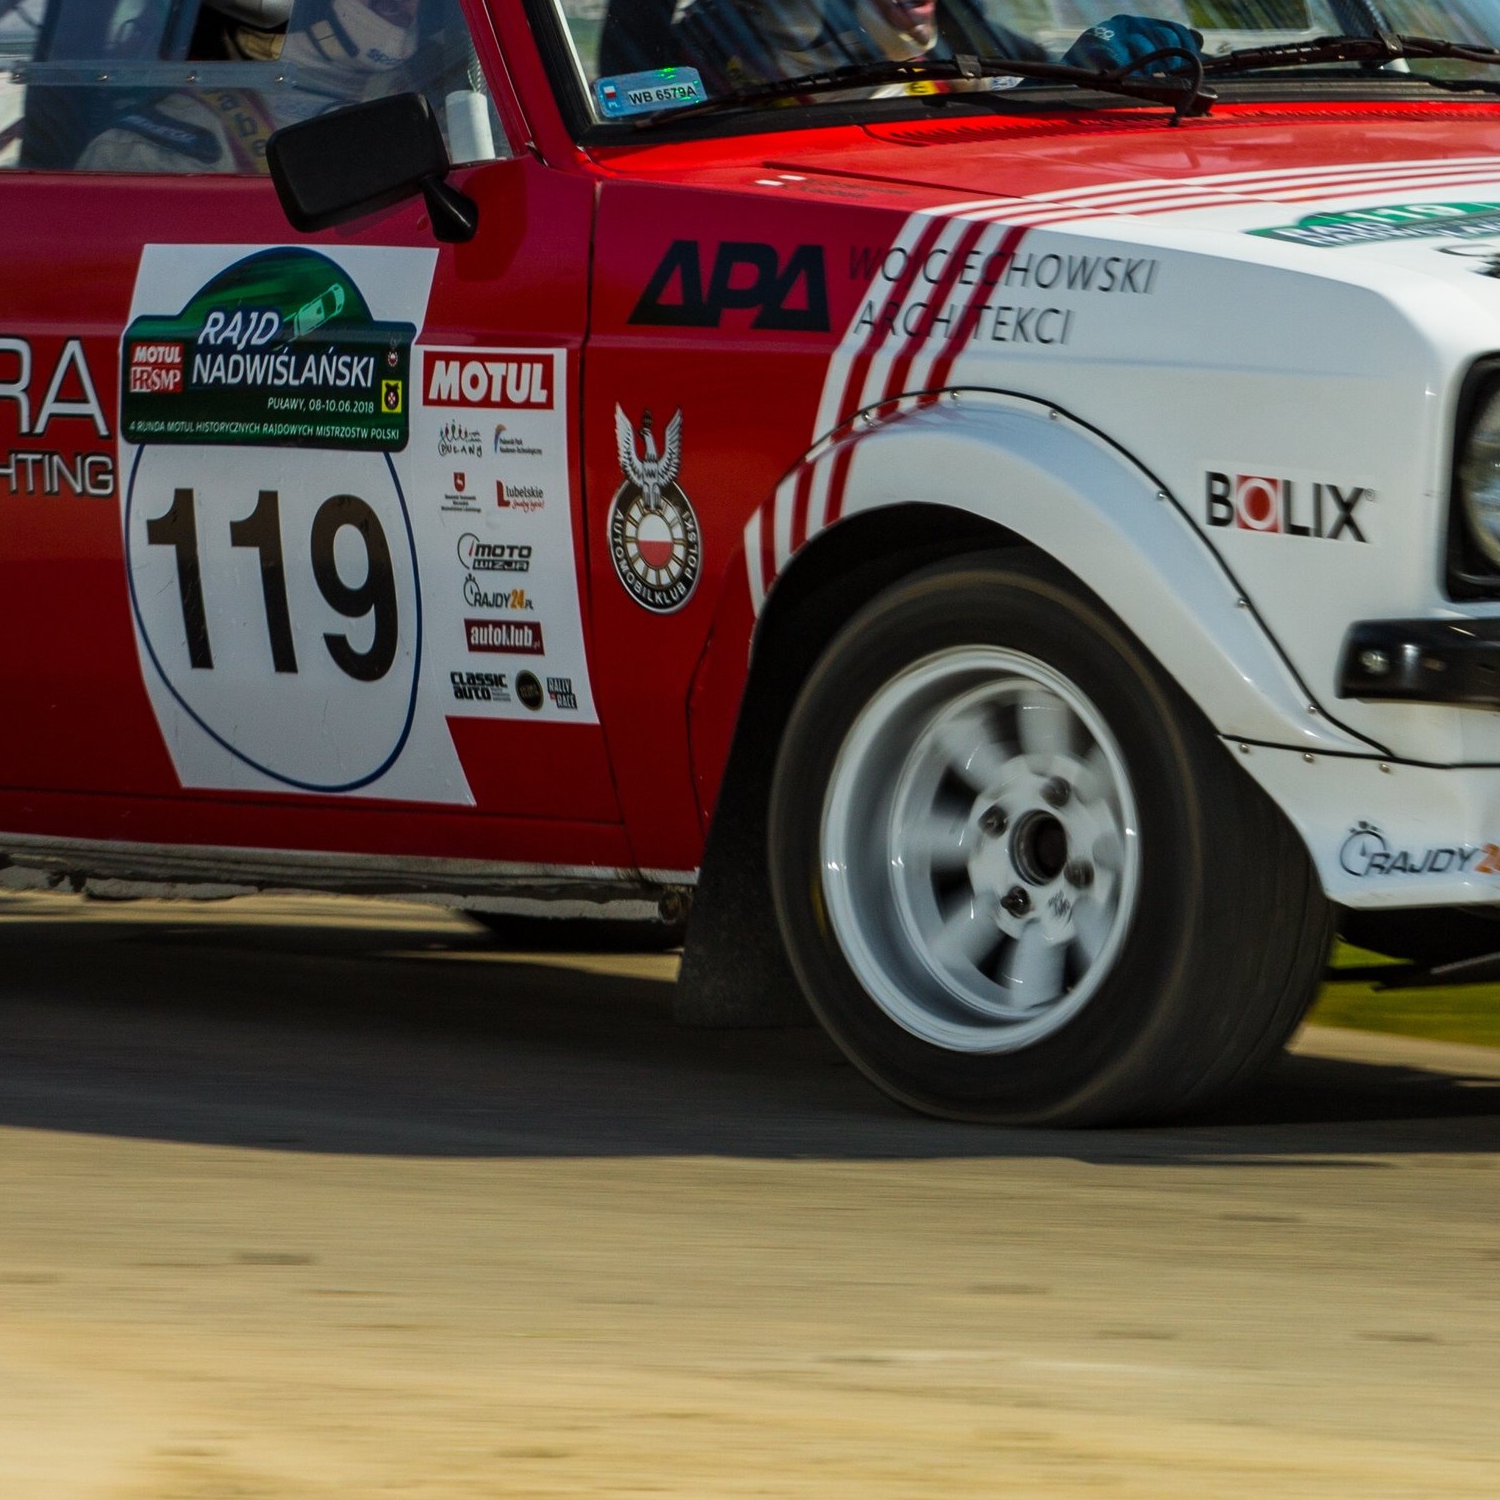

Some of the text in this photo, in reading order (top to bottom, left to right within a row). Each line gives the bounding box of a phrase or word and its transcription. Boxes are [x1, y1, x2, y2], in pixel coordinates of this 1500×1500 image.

[628, 85, 698, 105] WB 6579A
[626, 239, 832, 333] APA
[197, 310, 280, 350] RAJD
[853, 299, 1076, 346] ARCHITEKCI
[133, 345, 181, 364] MOTUL
[191, 346, 375, 388] NADWIŚLAŃSKI
[428, 360, 548, 403] MOTUL
[267, 396, 375, 414] PUŁAWY, 08-10.06.2018
[196, 421, 261, 435] HISTORYCZNYCH
[262, 423, 314, 437] RAJDOWYCH
[315, 425, 369, 440] MISTRZOSTW
[370, 427, 400, 440] POLSKI
[506, 485, 544, 499] lubelskie
[1205, 470, 1368, 544] BOLIX
[474, 560, 529, 571] WIZJA
[475, 543, 533, 559] MOTO
[613, 508, 698, 606] AUTOMOBILKLUB POLSKI
[145, 487, 399, 682] 119
